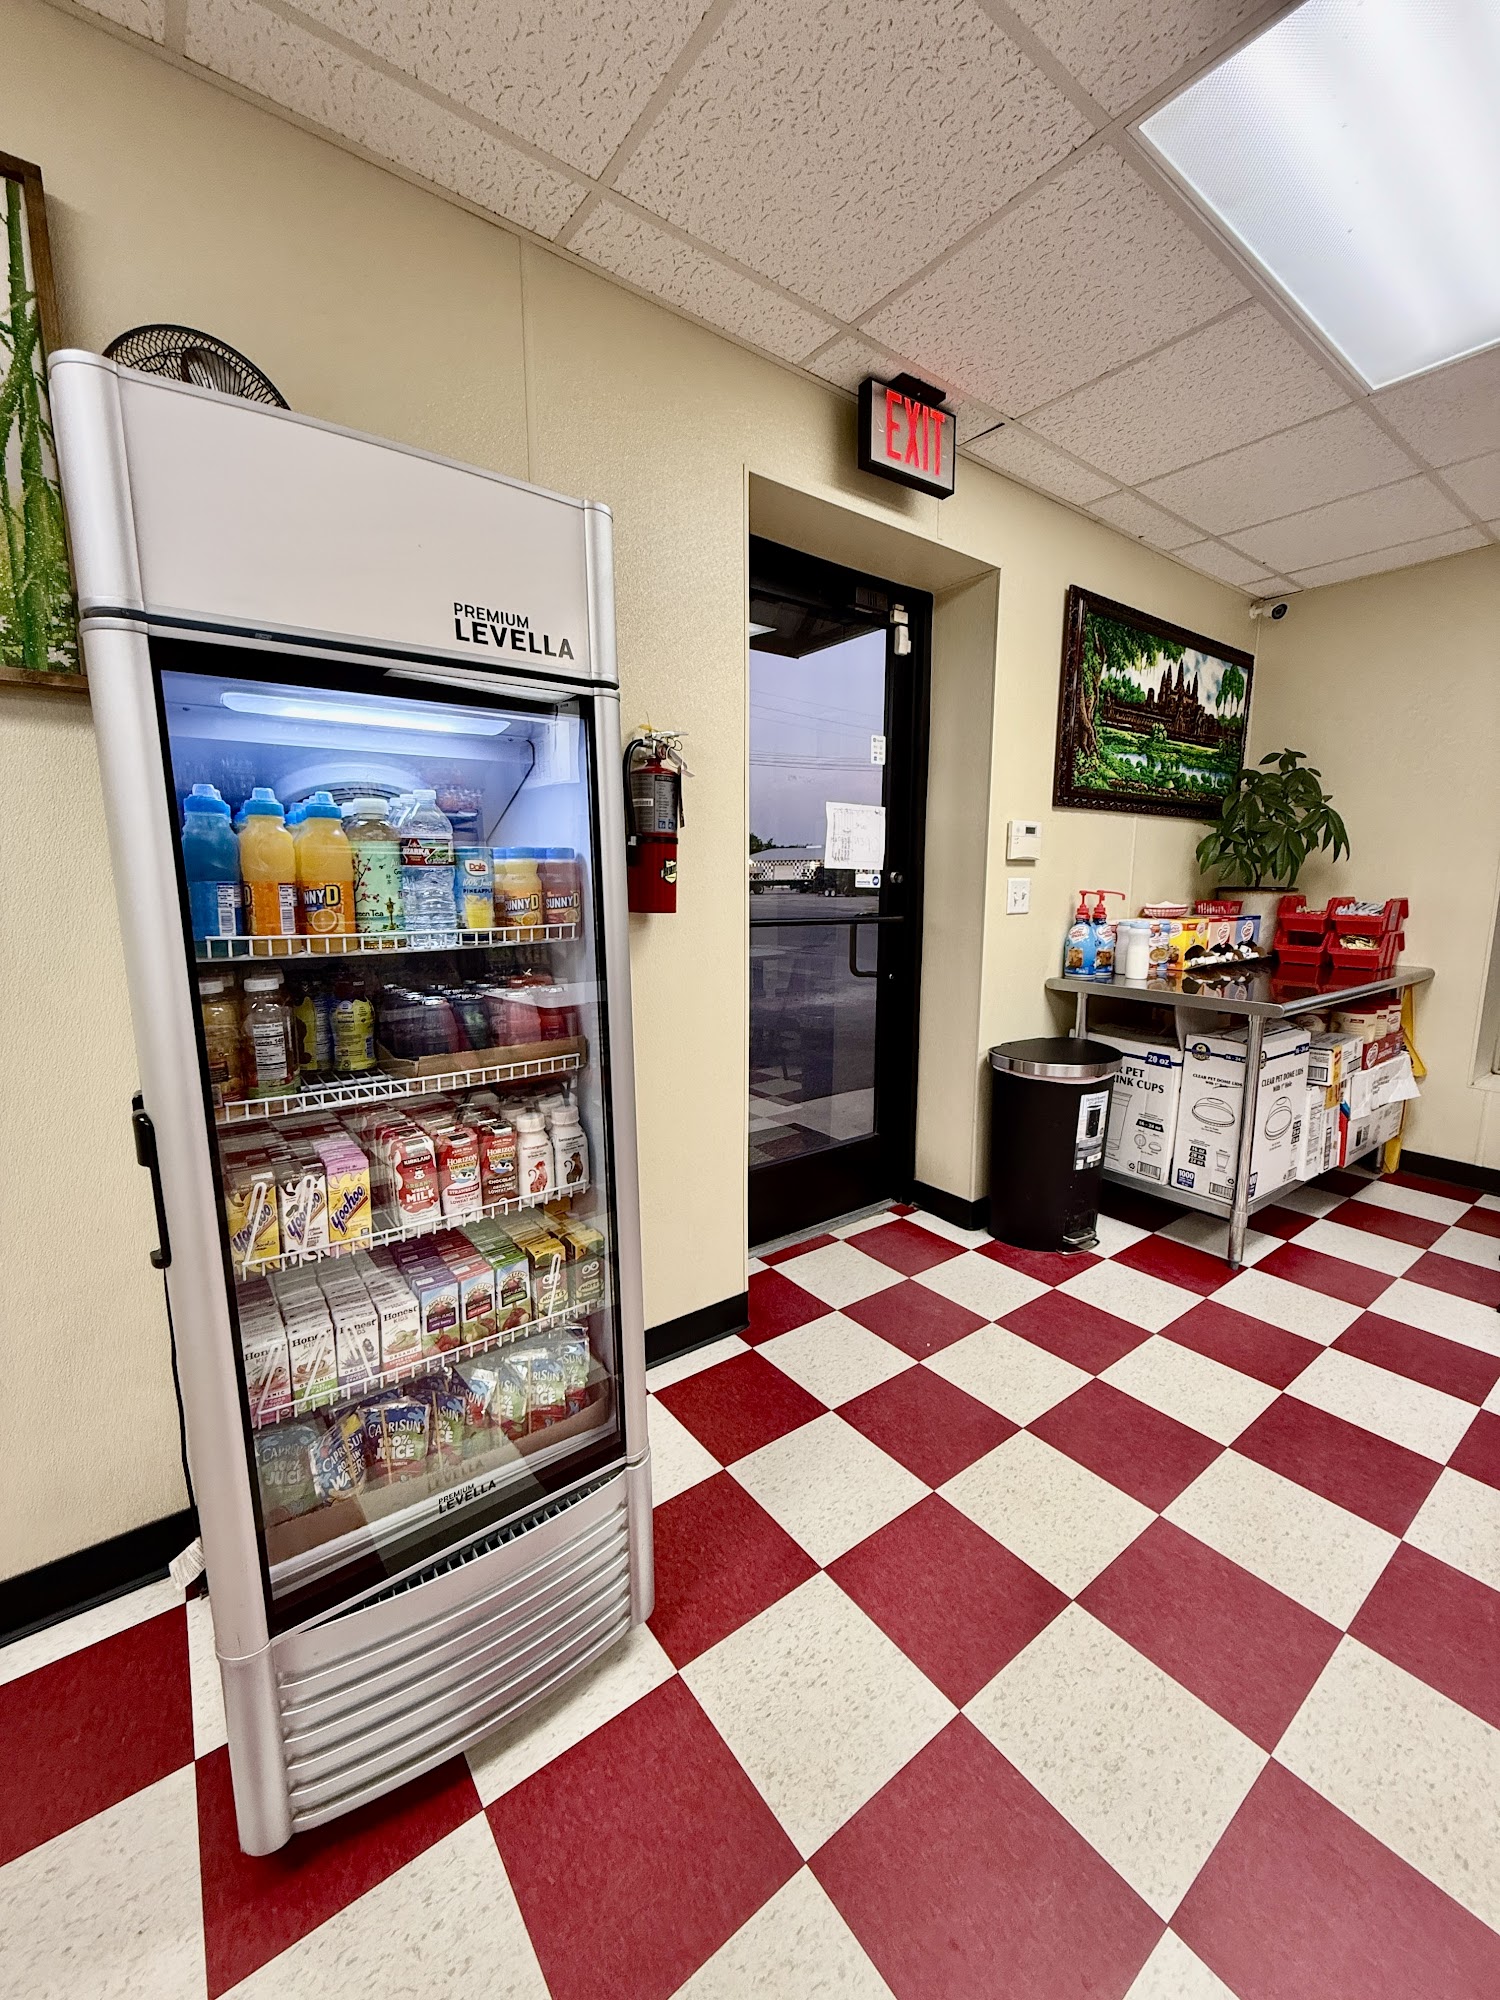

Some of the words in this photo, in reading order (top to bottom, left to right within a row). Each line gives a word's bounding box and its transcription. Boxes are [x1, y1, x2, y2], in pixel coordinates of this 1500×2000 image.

[886, 389, 945, 476] EXIT
[453, 602, 529, 629] PREMIUM
[454, 617, 574, 660] LEVELLA
[370, 909, 384, 917] Tea
[1148, 1054, 1158, 1063] 20
[1160, 1057, 1170, 1066] oz
[1125, 1066, 1145, 1078] PET
[1261, 1076, 1275, 1087] CLEAR
[1275, 1074, 1283, 1083] PET
[1283, 1070, 1295, 1080] DOME
[1136, 1079, 1165, 1094] CUPS
[1216, 1077, 1231, 1085] DOME
[487, 1145, 516, 1157] HORIZON
[447, 1153, 477, 1166] HORIZON
[1178, 1170, 1194, 1180] 1000
[406, 1188, 434, 1203] MILK
[449, 1184, 479, 1195] STRAWBERRY
[331, 1185, 366, 1235] Yoohoo
[383, 1305, 418, 1321] Honest
[390, 1348, 418, 1360] ORGANIC
[438, 1483, 475, 1505] PREMIUM
[438, 1480, 496, 1514] LEVELLA
